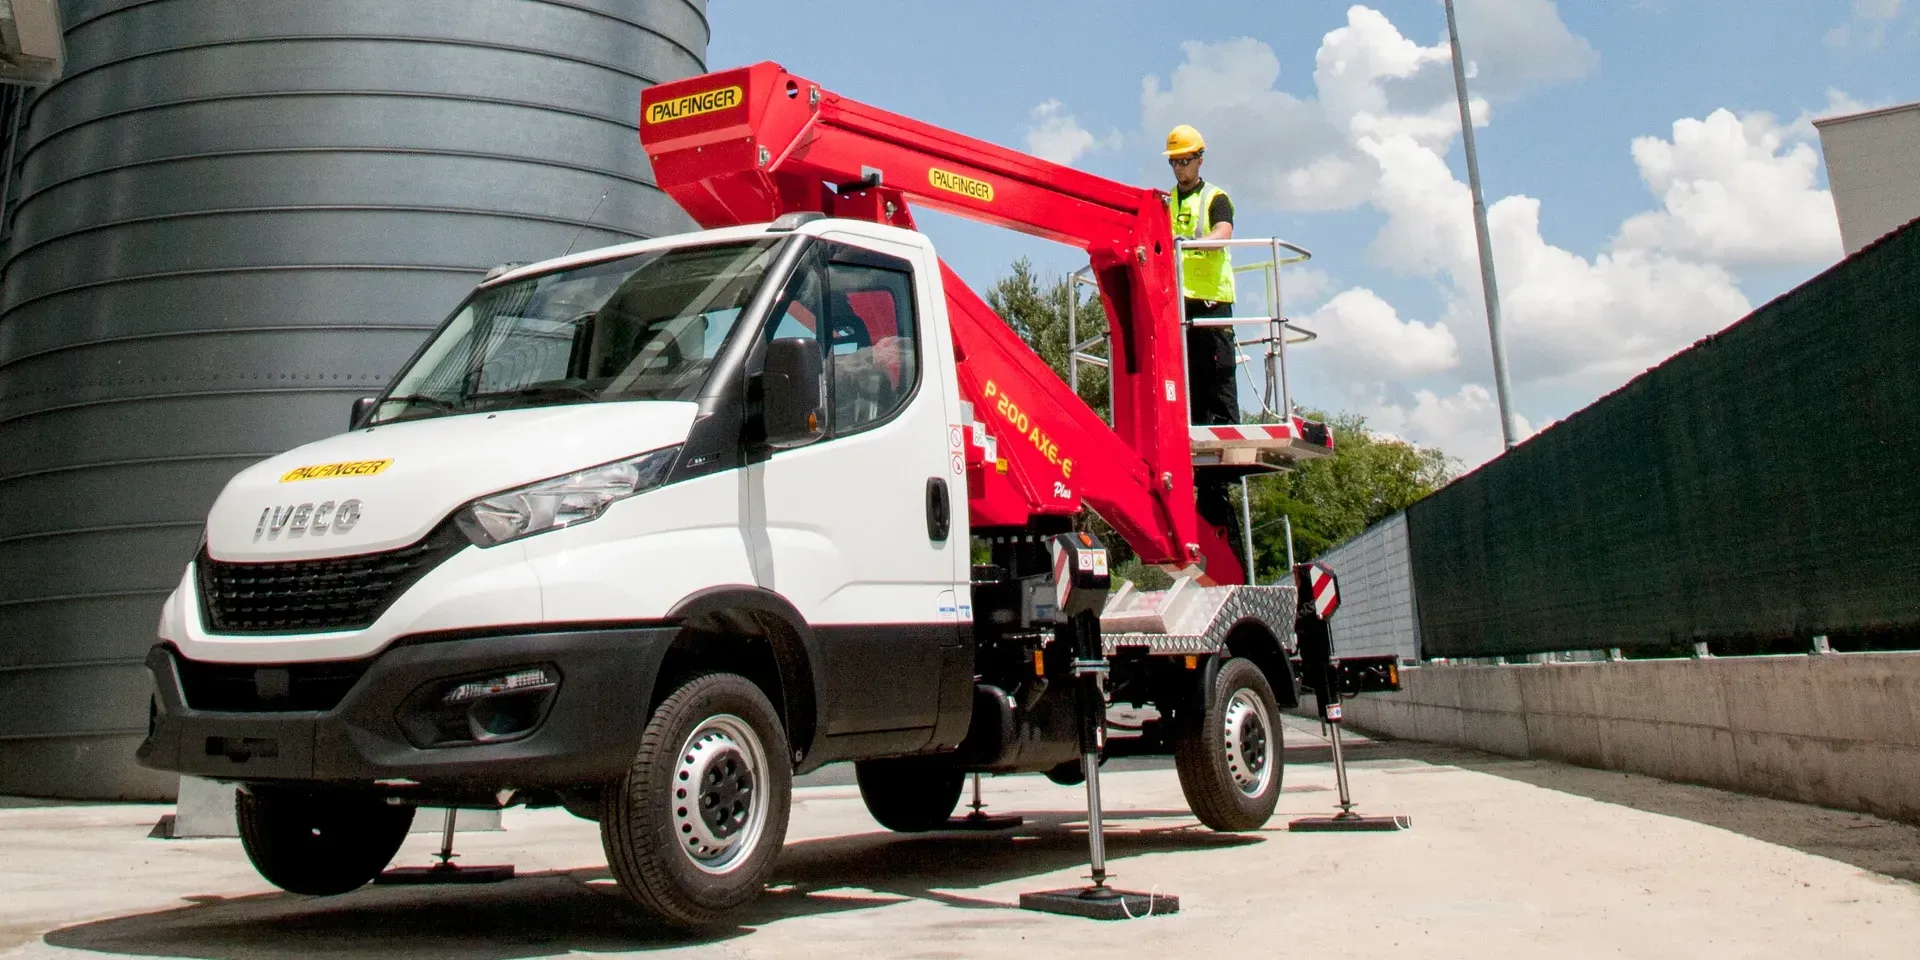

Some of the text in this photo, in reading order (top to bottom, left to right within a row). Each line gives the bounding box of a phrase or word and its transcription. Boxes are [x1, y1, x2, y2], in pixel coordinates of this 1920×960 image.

[652, 89, 735, 121] PALFINGER
[933, 170, 989, 199] PALFINGER
[985, 380, 1072, 479] P 200 AXE-E
[285, 460, 386, 481] PALFINGER
[1054, 481, 1071, 499] Plus
[255, 499, 362, 534] IVECO
